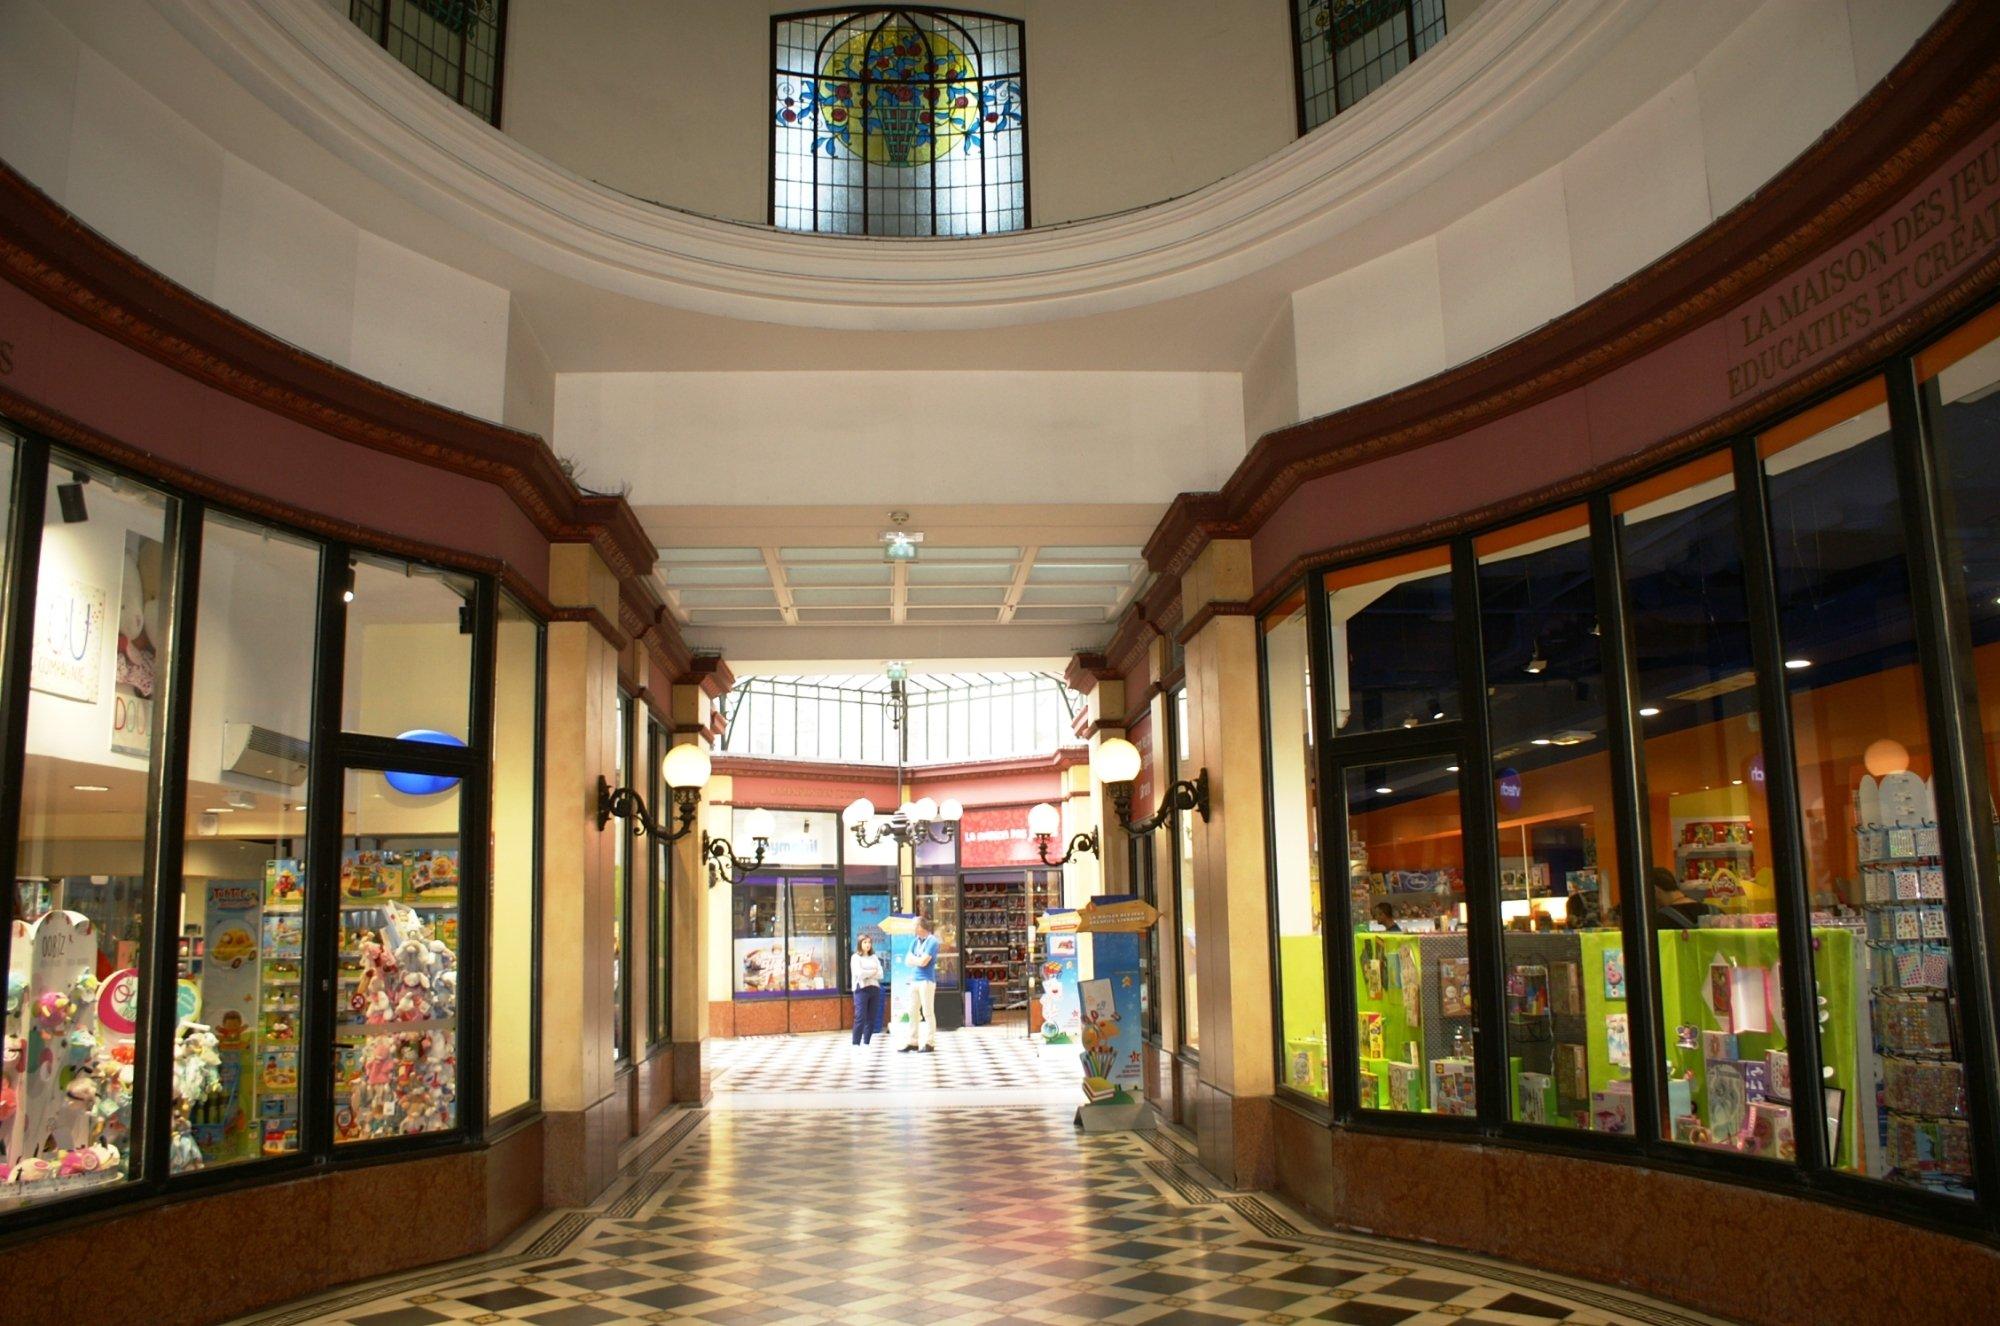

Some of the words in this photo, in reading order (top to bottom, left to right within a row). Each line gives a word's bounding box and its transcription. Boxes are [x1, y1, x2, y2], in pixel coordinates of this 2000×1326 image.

[1726, 290, 1872, 400] EDUCATIFS
[1877, 267, 1909, 316] ET
[1741, 306, 1776, 346] LA
[1777, 232, 1887, 325] MAISON
[1892, 188, 1945, 256] DES
